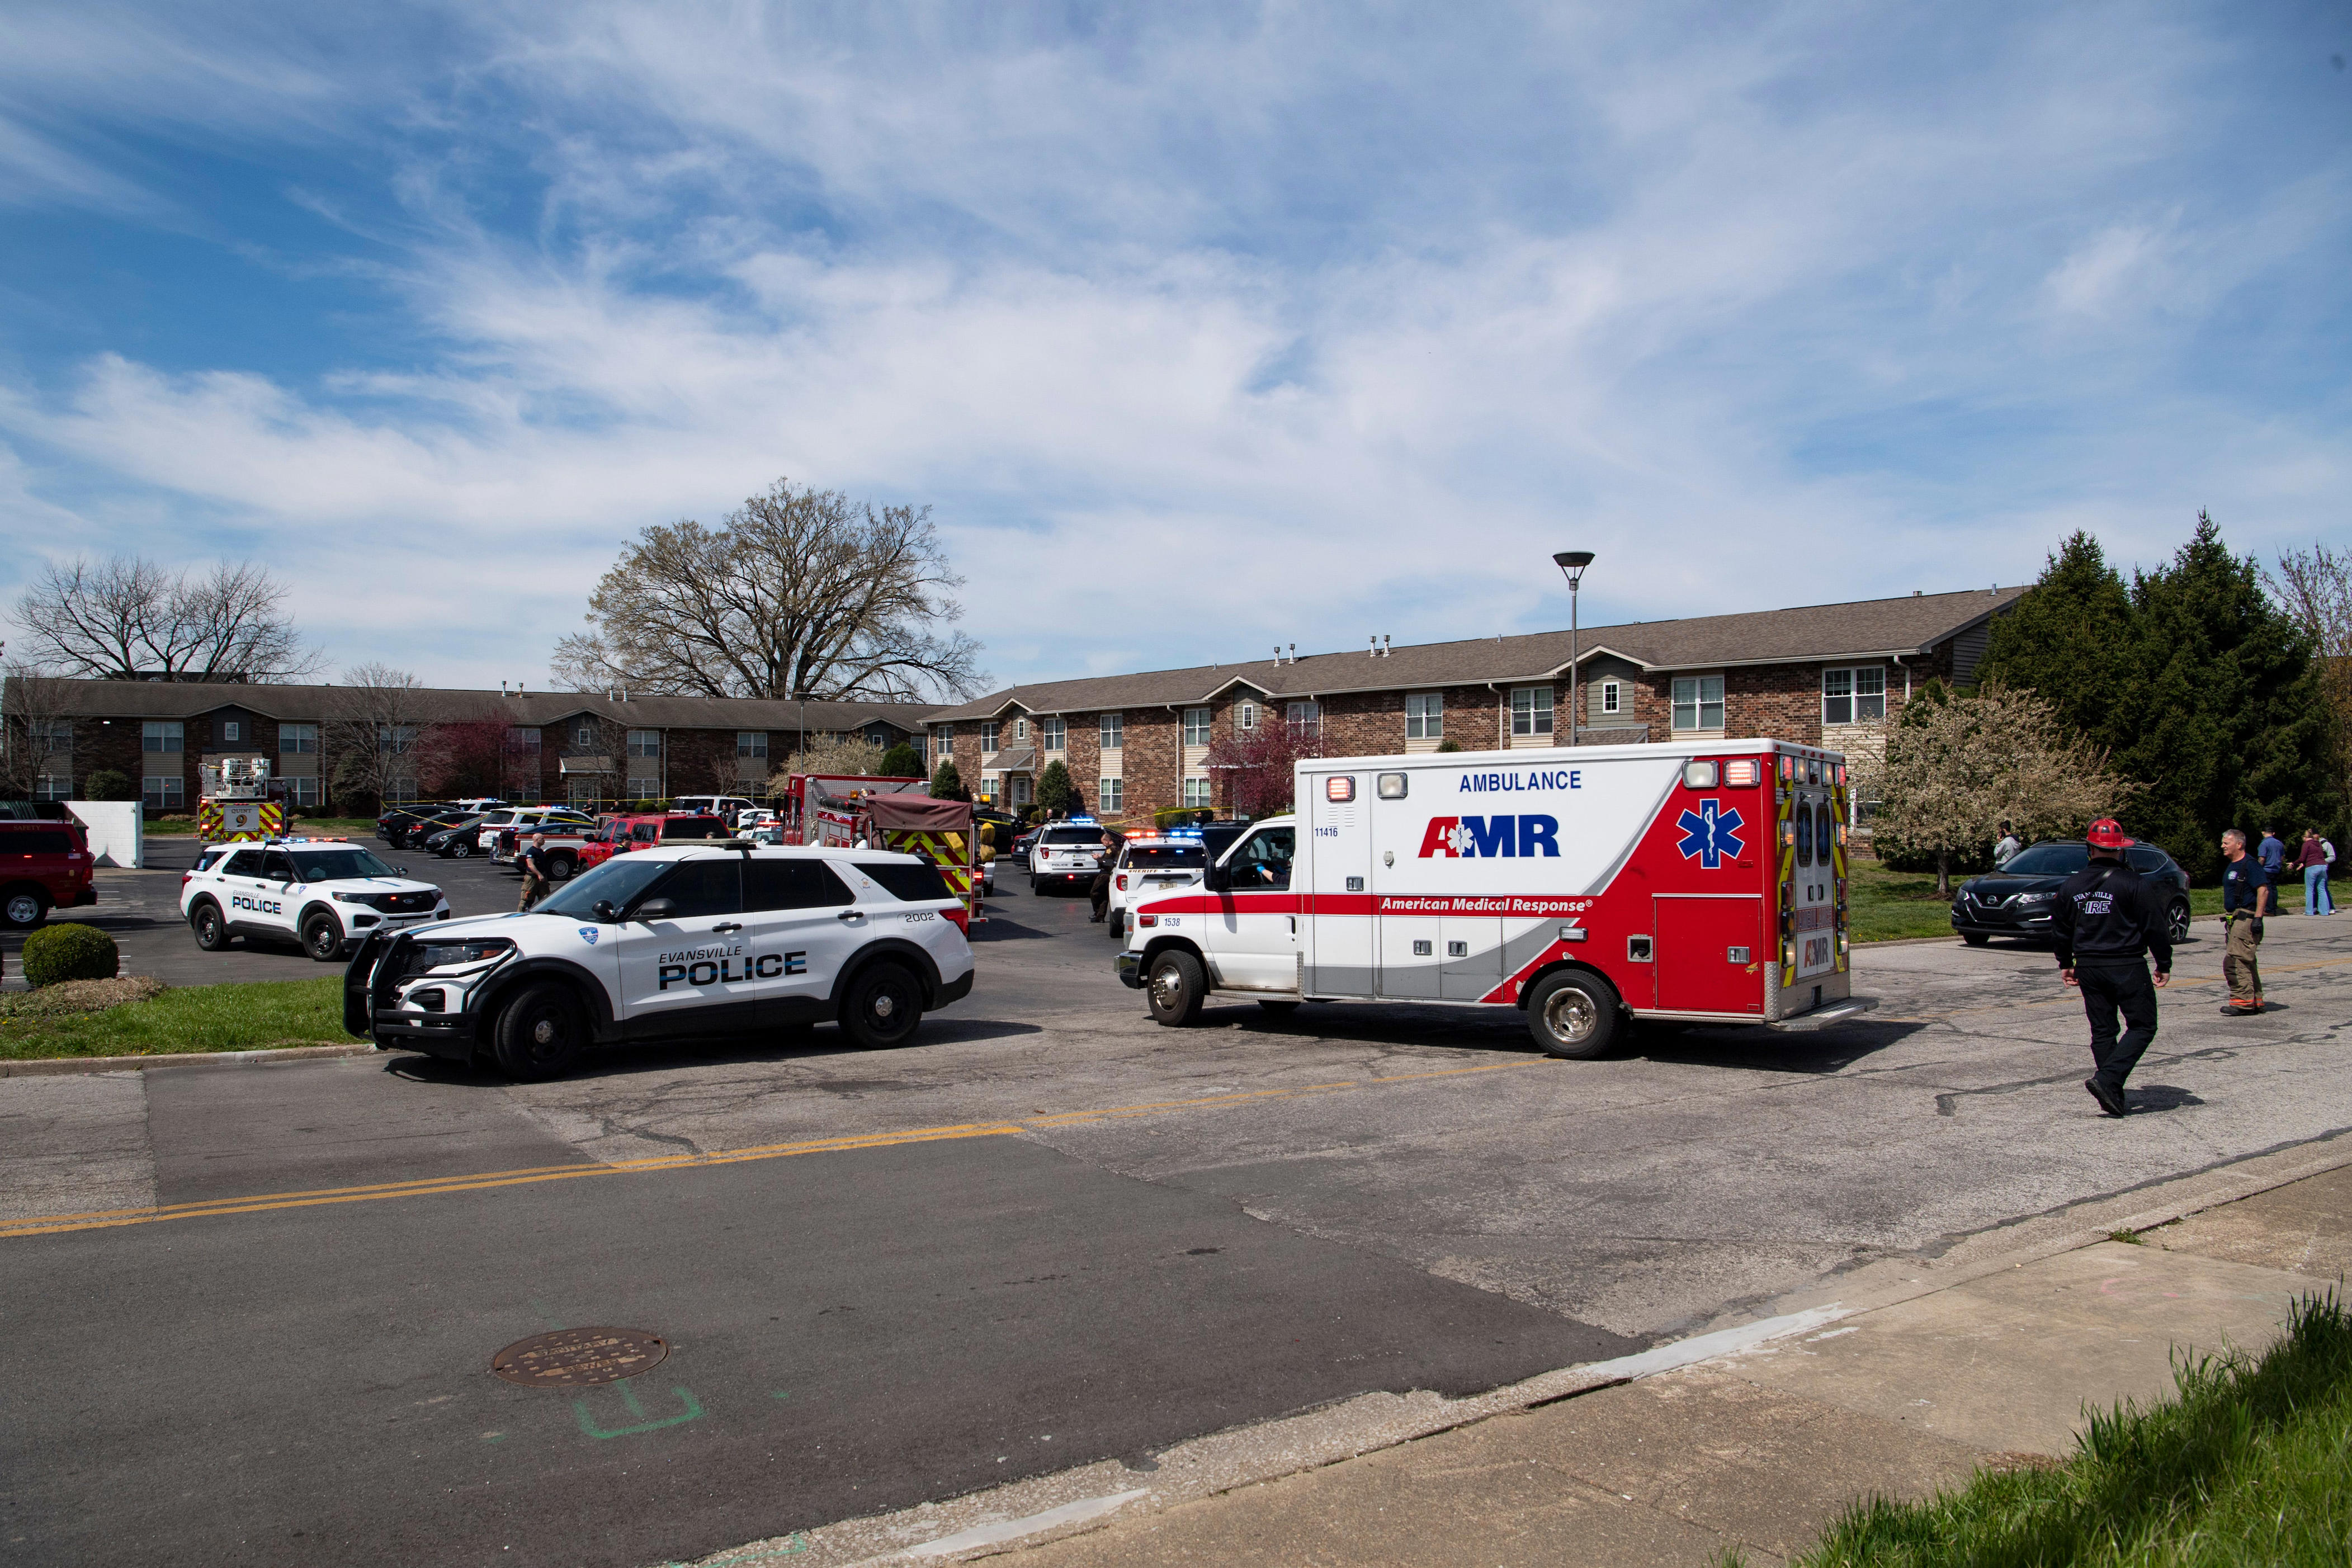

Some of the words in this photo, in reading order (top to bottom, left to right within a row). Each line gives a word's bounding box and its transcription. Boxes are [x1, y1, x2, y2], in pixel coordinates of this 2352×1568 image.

[1460, 771, 1581, 792] AMBULANCE
[236, 814, 247, 828] 9
[1315, 828, 1338, 837] 11416
[1418, 814, 1561, 858] AMR
[233, 890, 260, 898] EVANSVILLE
[233, 896, 281, 914] POLICE
[1381, 897, 1449, 910] American
[1452, 898, 1509, 911] Medical
[905, 912, 936, 923] 2002
[1164, 918, 1180, 927] 1538
[1797, 906, 1833, 931] AMBULANCE
[659, 946, 742, 964] EVANSVILLE
[1804, 937, 1829, 968] AMR
[659, 951, 807, 990] POLICE
[535, 1338, 612, 1357] SANITARY
[561, 1358, 616, 1372] SEWER
